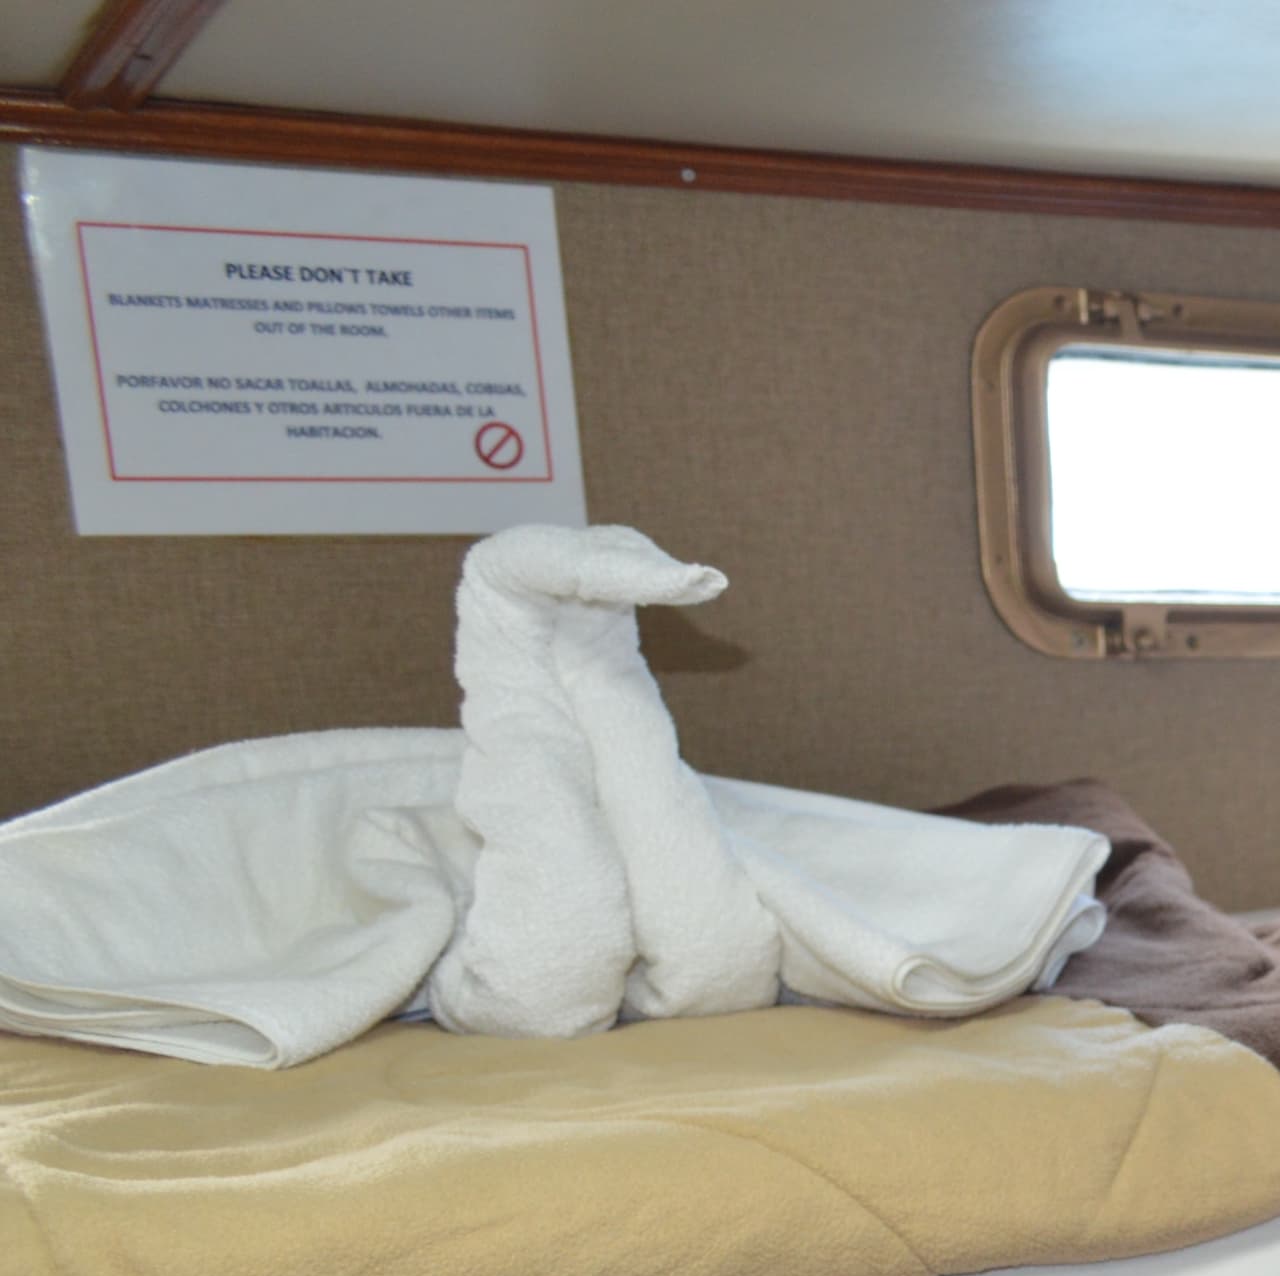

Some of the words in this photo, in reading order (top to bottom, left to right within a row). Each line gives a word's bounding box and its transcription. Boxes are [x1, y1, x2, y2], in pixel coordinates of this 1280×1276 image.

[225, 263, 293, 282] PLEASE
[366, 269, 412, 287] TAKE
[108, 293, 182, 308] BLANKETS
[187, 297, 268, 312] MATRESSES
[273, 301, 304, 313] AND
[308, 301, 366, 316] PILLOWS
[370, 303, 424, 318] TOWELS
[428, 305, 470, 320] OTHER
[476, 307, 515, 320] ITEMS
[254, 321, 284, 335] OUT
[288, 322, 306, 335] OF
[310, 323, 335, 336] THE
[117, 374, 202, 389] PORFAVOR
[207, 377, 230, 390] NO
[236, 378, 283, 391] SACAR
[159, 400, 250, 414] COLCHONES
[254, 402, 263, 414] Y
[268, 402, 319, 415] OTROS
[323, 403, 402, 417] ARTICULOS
[406, 404, 450, 417] FUERA
[456, 406, 474, 417] DE
[478, 406, 495, 417] LA
